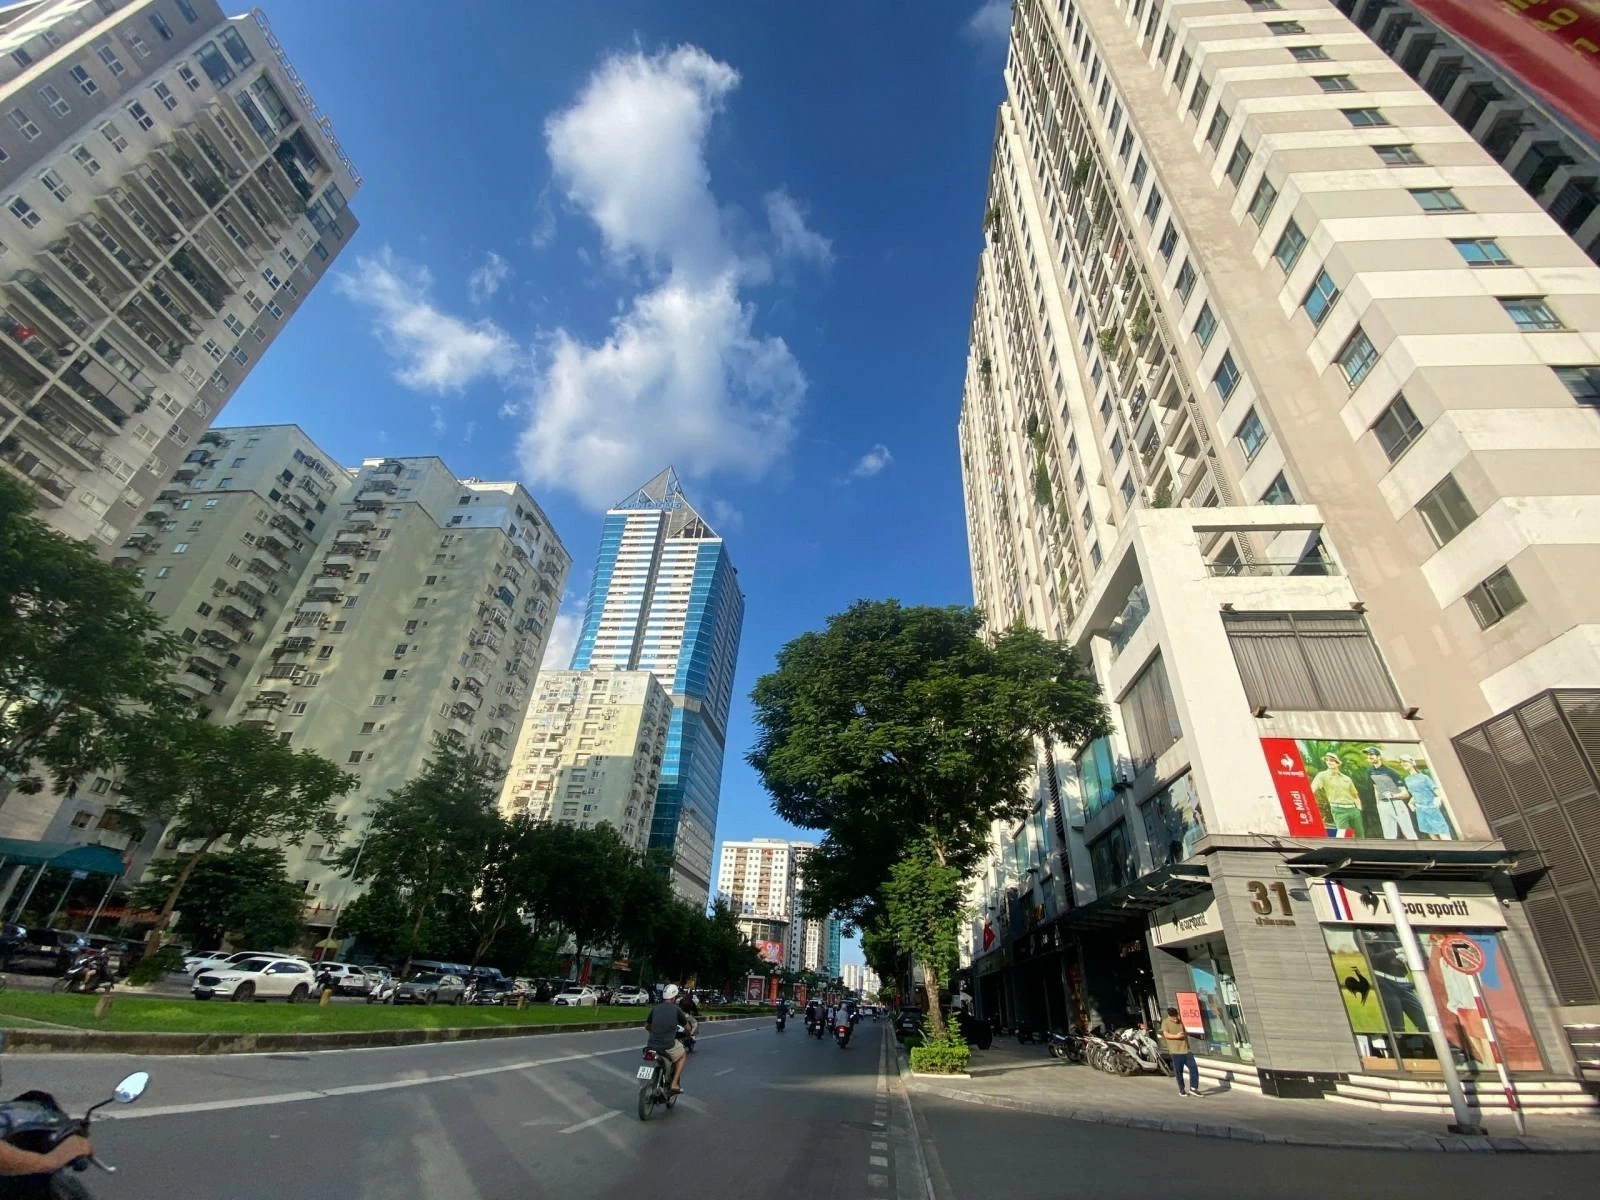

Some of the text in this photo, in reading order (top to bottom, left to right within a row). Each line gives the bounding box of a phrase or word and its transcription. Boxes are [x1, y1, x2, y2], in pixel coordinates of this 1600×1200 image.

[251, 7, 364, 188] GOLDEN PALACE
[1290, 790, 1304, 810] Midi
[1299, 813, 1309, 825] Le
[1245, 880, 1294, 917] 31
[1402, 902, 1426, 917] coq
[1427, 900, 1469, 918] sportif
[1189, 1009, 1200, 1018] 50
